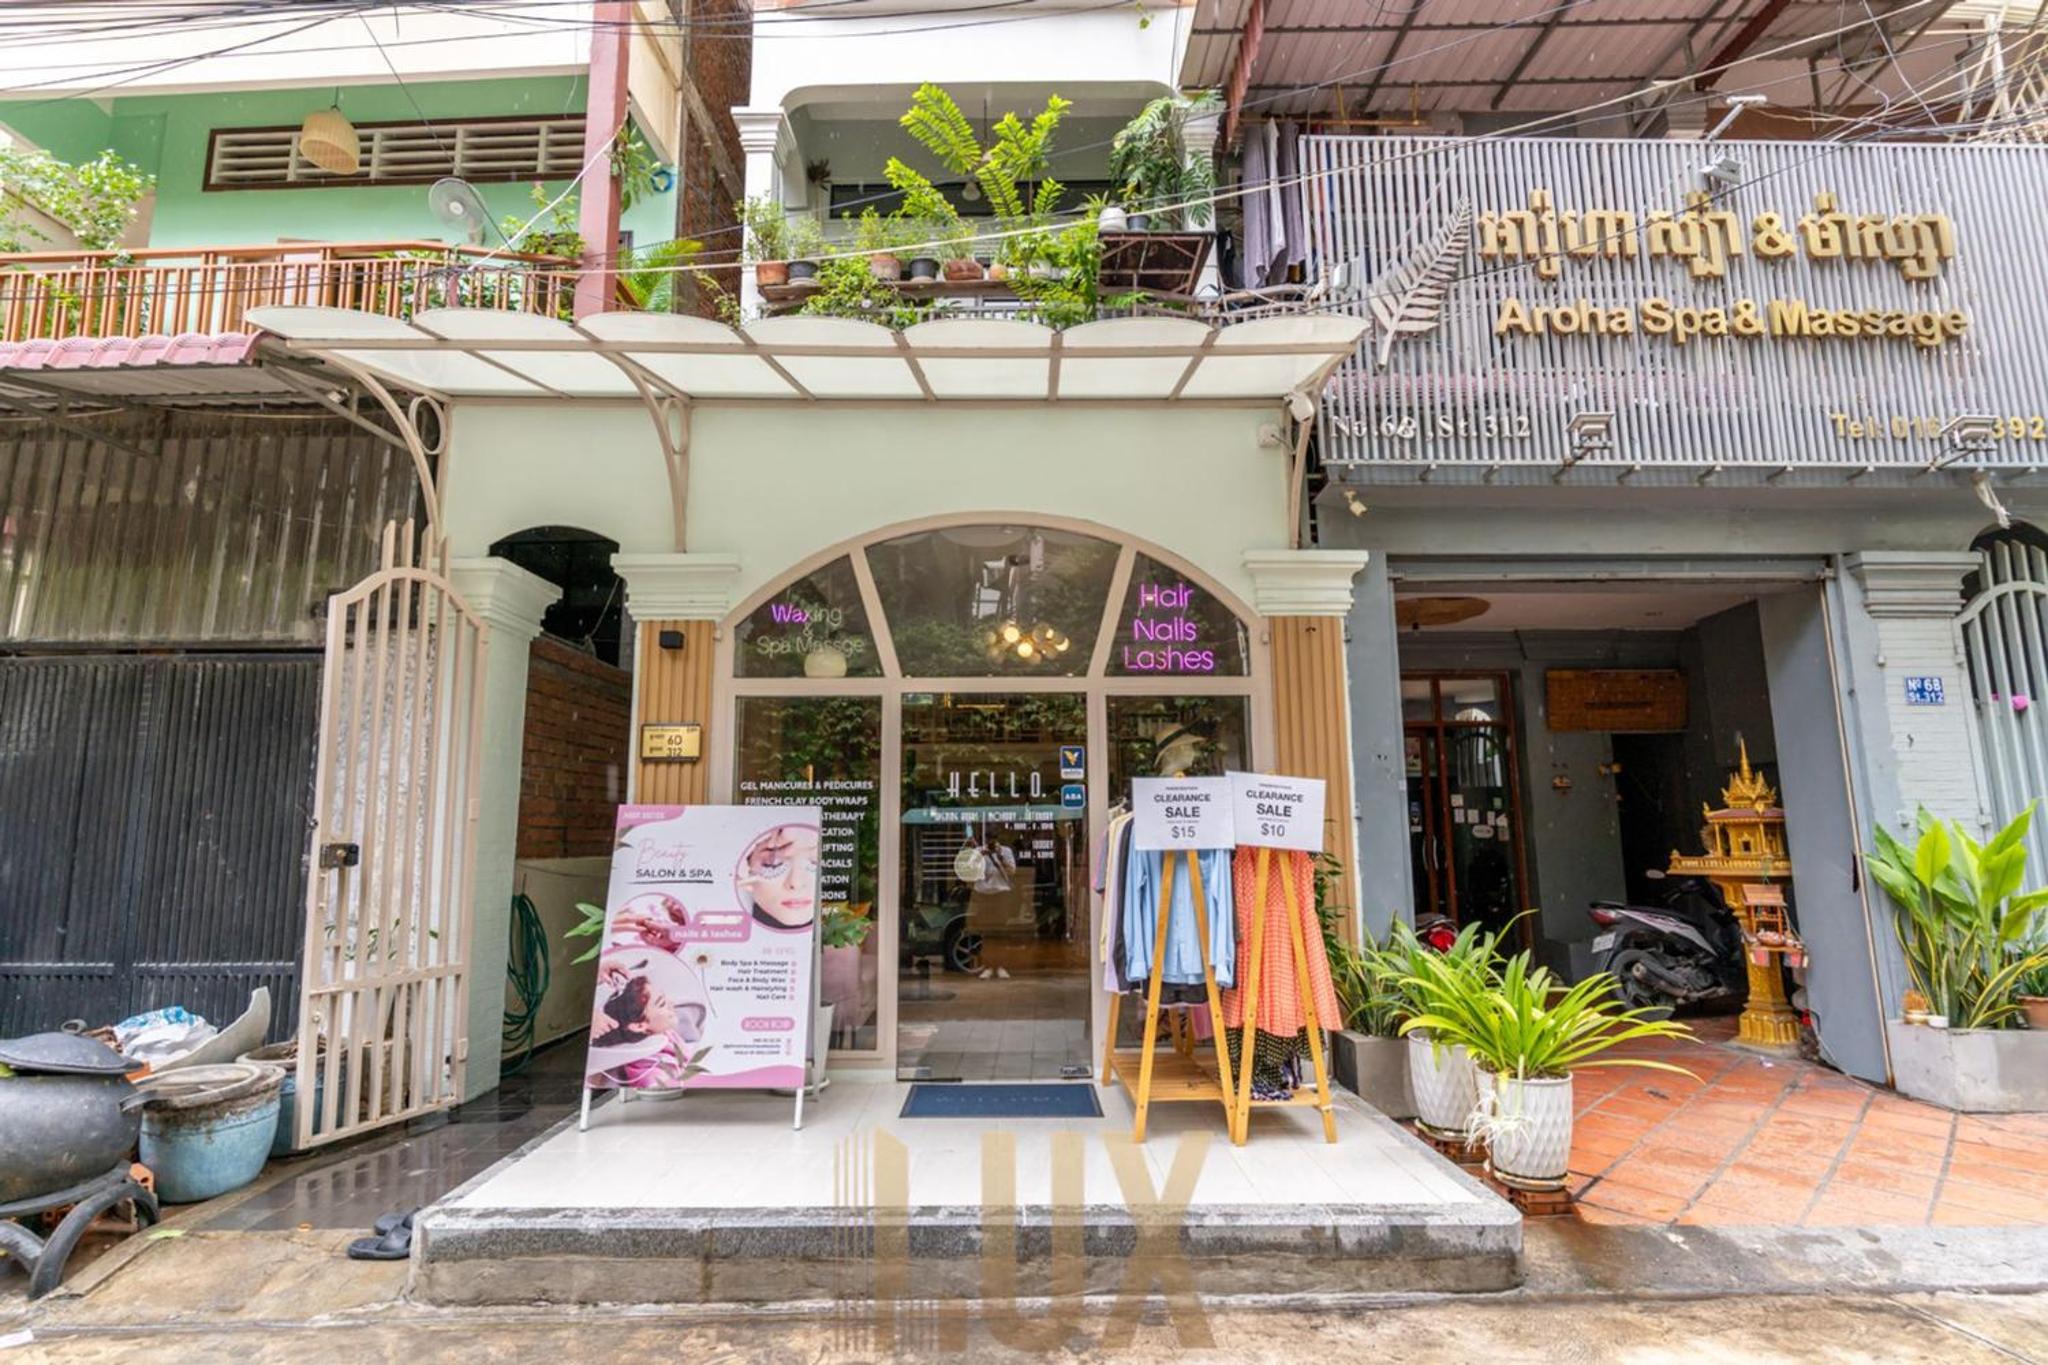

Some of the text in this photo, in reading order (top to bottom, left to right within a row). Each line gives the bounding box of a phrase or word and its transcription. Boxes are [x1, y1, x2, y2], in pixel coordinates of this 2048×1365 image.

[1753, 211, 1797, 258] &
[1495, 297, 1633, 335] Aroha
[1641, 297, 1729, 343] Spa
[1767, 299, 1969, 346] Massage
[1139, 583, 1194, 608] Hair
[771, 602, 842, 627] Waxing
[1134, 616, 1197, 641] Nails
[757, 636, 791, 659] Spa
[1124, 645, 1214, 670] Lashes
[740, 781, 758, 791] GEL
[760, 780, 813, 790] MANICURES
[823, 780, 873, 790] PEDICURES
[744, 796, 868, 806] FRENCH CLAY BODY WRAPS
[1153, 793, 1211, 803] CLEARANCE
[1245, 789, 1304, 803] CLEARANCE
[1164, 806, 1201, 818] SALE
[1256, 803, 1292, 817] SALE
[1171, 825, 1196, 839] $15
[1260, 822, 1286, 838] $10
[635, 869, 713, 878] SALON & SPA
